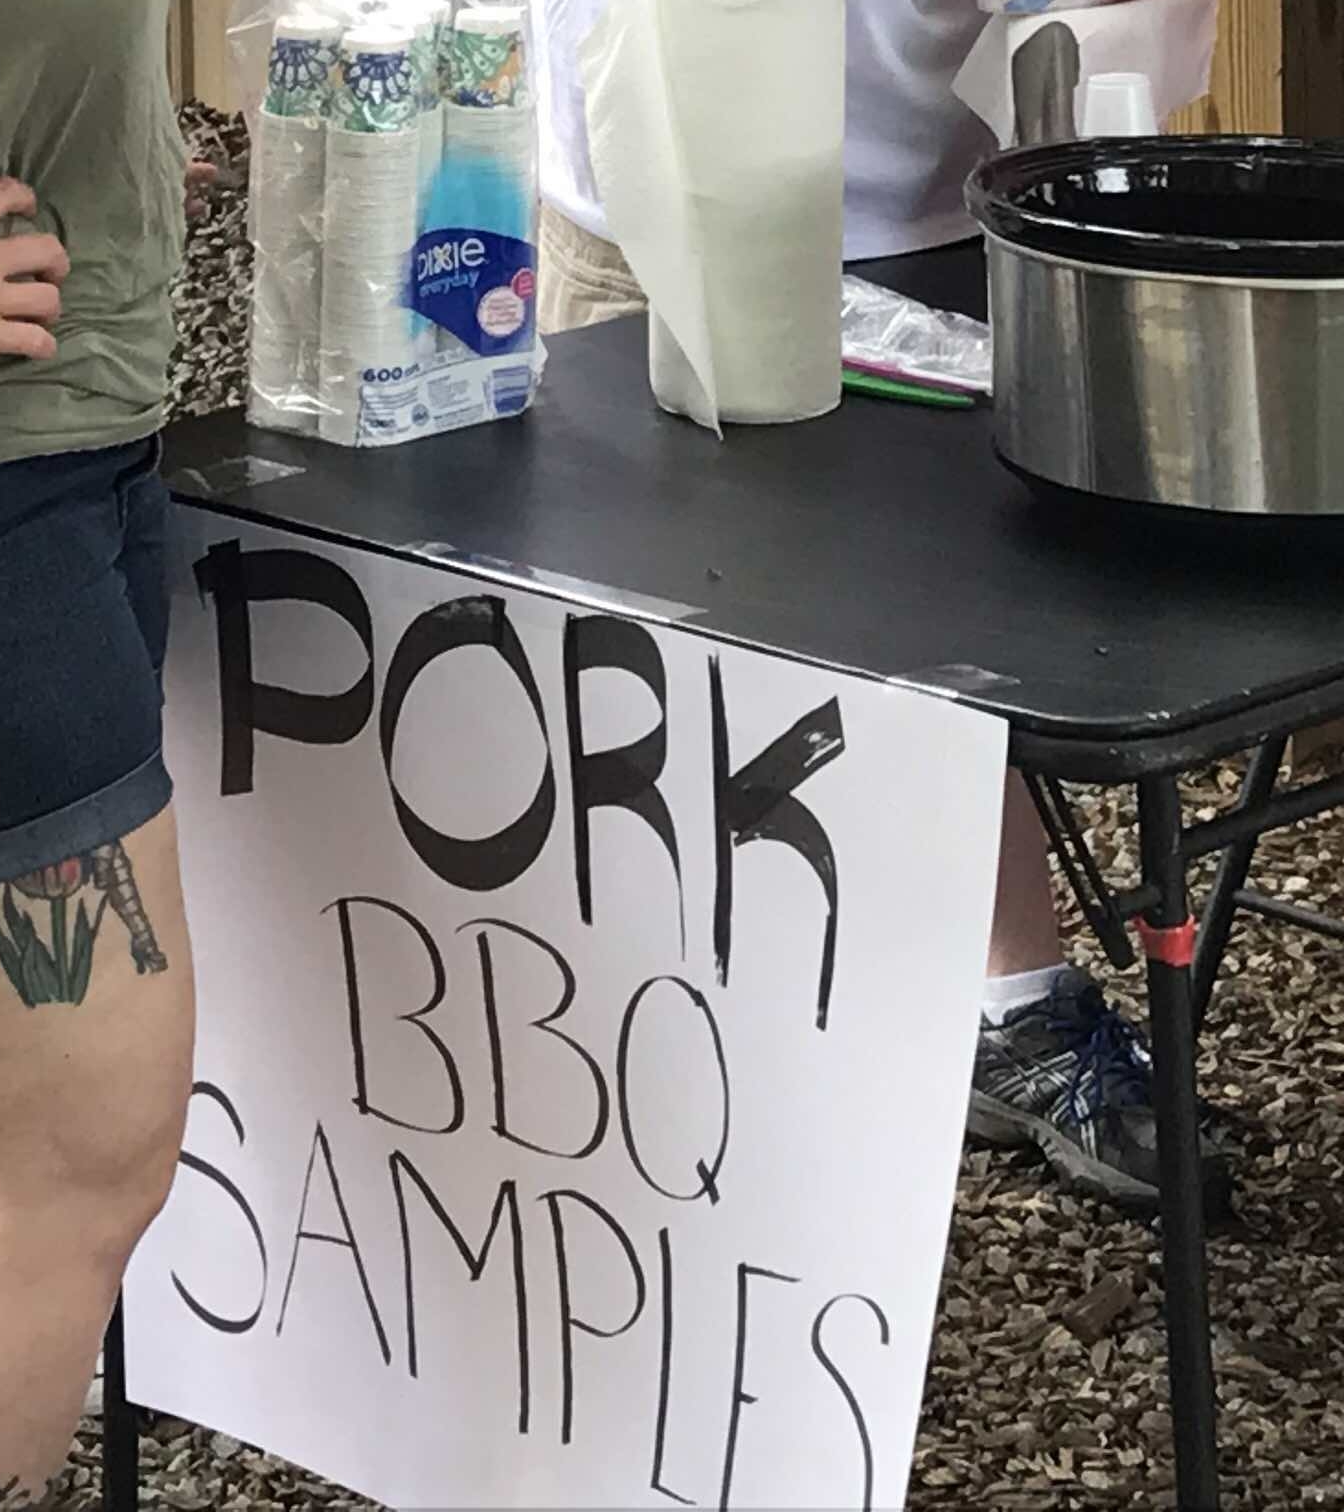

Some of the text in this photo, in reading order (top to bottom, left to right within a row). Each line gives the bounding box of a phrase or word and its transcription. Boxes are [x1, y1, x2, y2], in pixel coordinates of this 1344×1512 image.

[363, 366, 403, 383] 600
[192, 538, 847, 1032] PORK
[319, 895, 732, 1205] BBQ
[170, 1080, 891, 1512] SAMPLES
